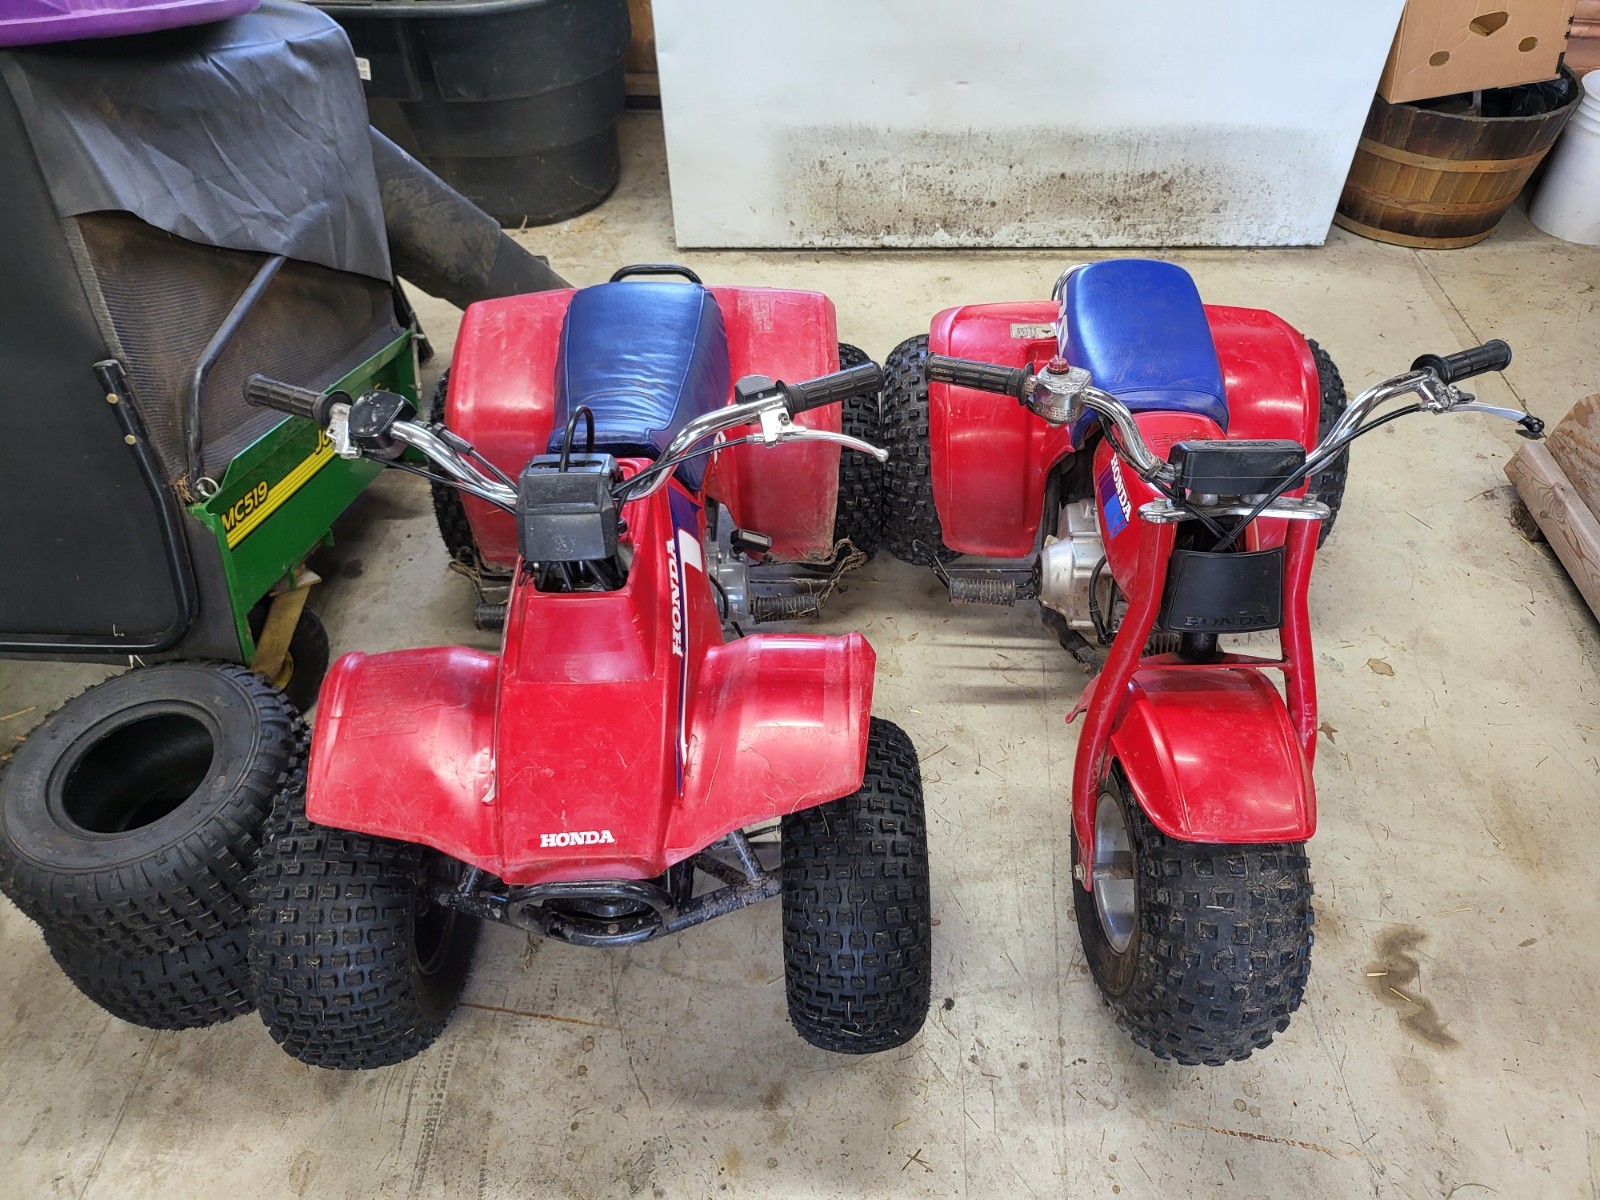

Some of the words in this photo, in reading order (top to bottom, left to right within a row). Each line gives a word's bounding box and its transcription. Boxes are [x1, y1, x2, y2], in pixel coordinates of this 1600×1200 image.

[221, 480, 268, 531] MC519
[1111, 452, 1132, 522] HONDA
[666, 537, 683, 658] HONDA
[1184, 615, 1270, 627] HONDA
[540, 829, 615, 848] HONDA
